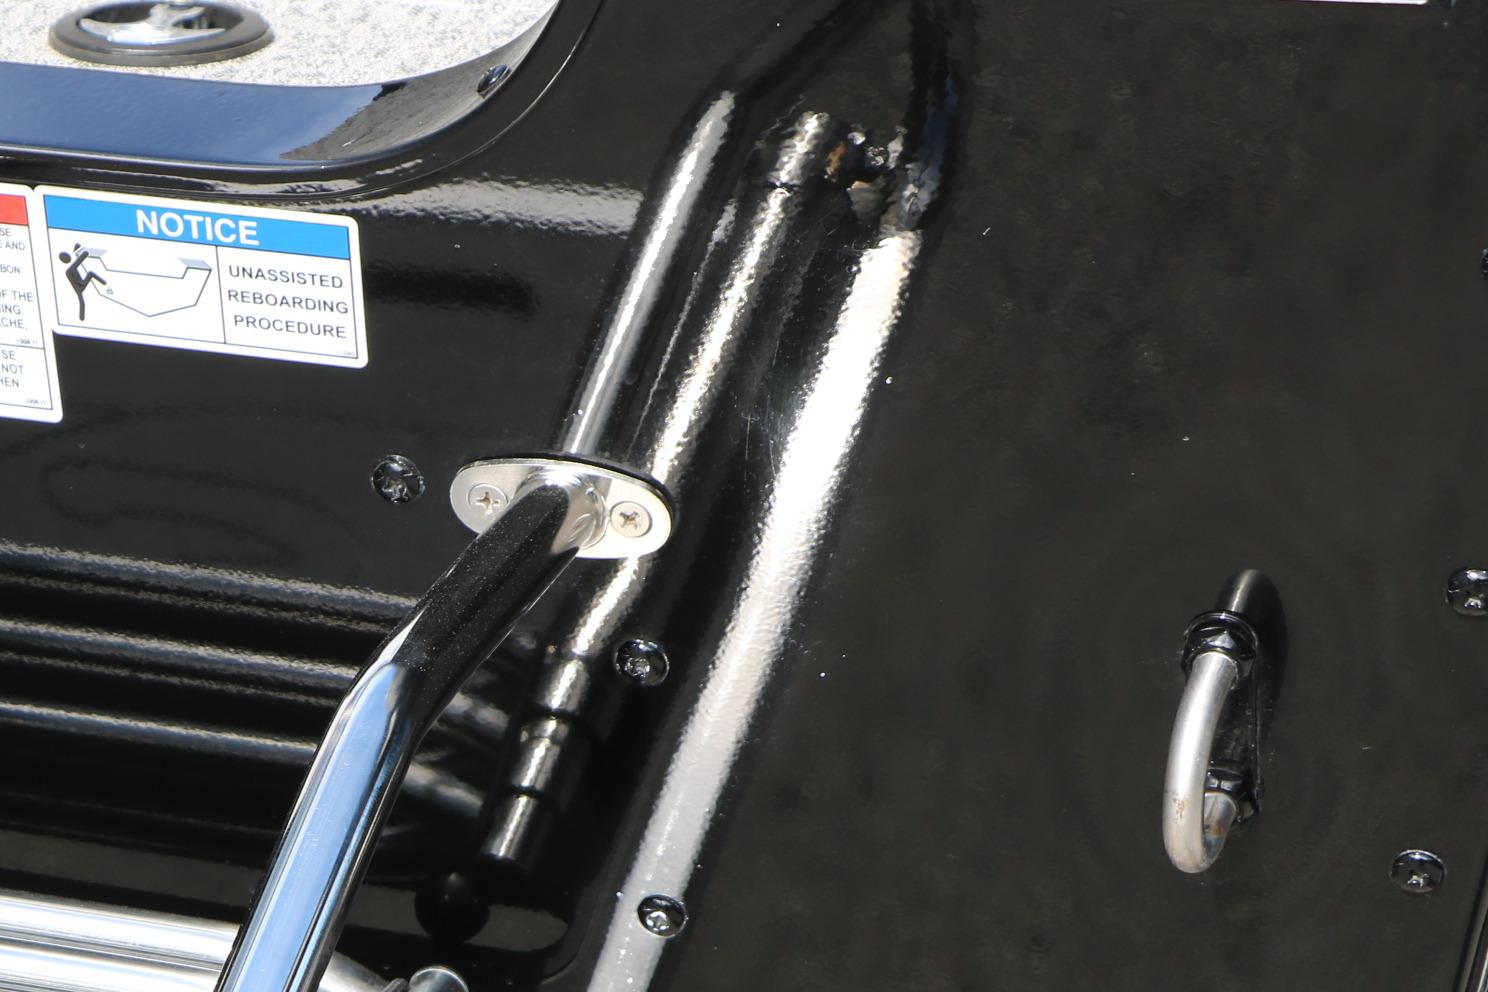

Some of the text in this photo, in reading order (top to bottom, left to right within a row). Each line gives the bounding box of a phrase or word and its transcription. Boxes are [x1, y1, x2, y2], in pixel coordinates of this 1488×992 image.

[136, 209, 260, 246] NOTICE
[5, 241, 26, 251] AND
[228, 265, 343, 288] UNASSISTED
[12, 290, 34, 302] THE
[228, 289, 349, 314] REBOARDING
[234, 314, 347, 339] PROCEDURE
[1, 363, 24, 375] NOT
